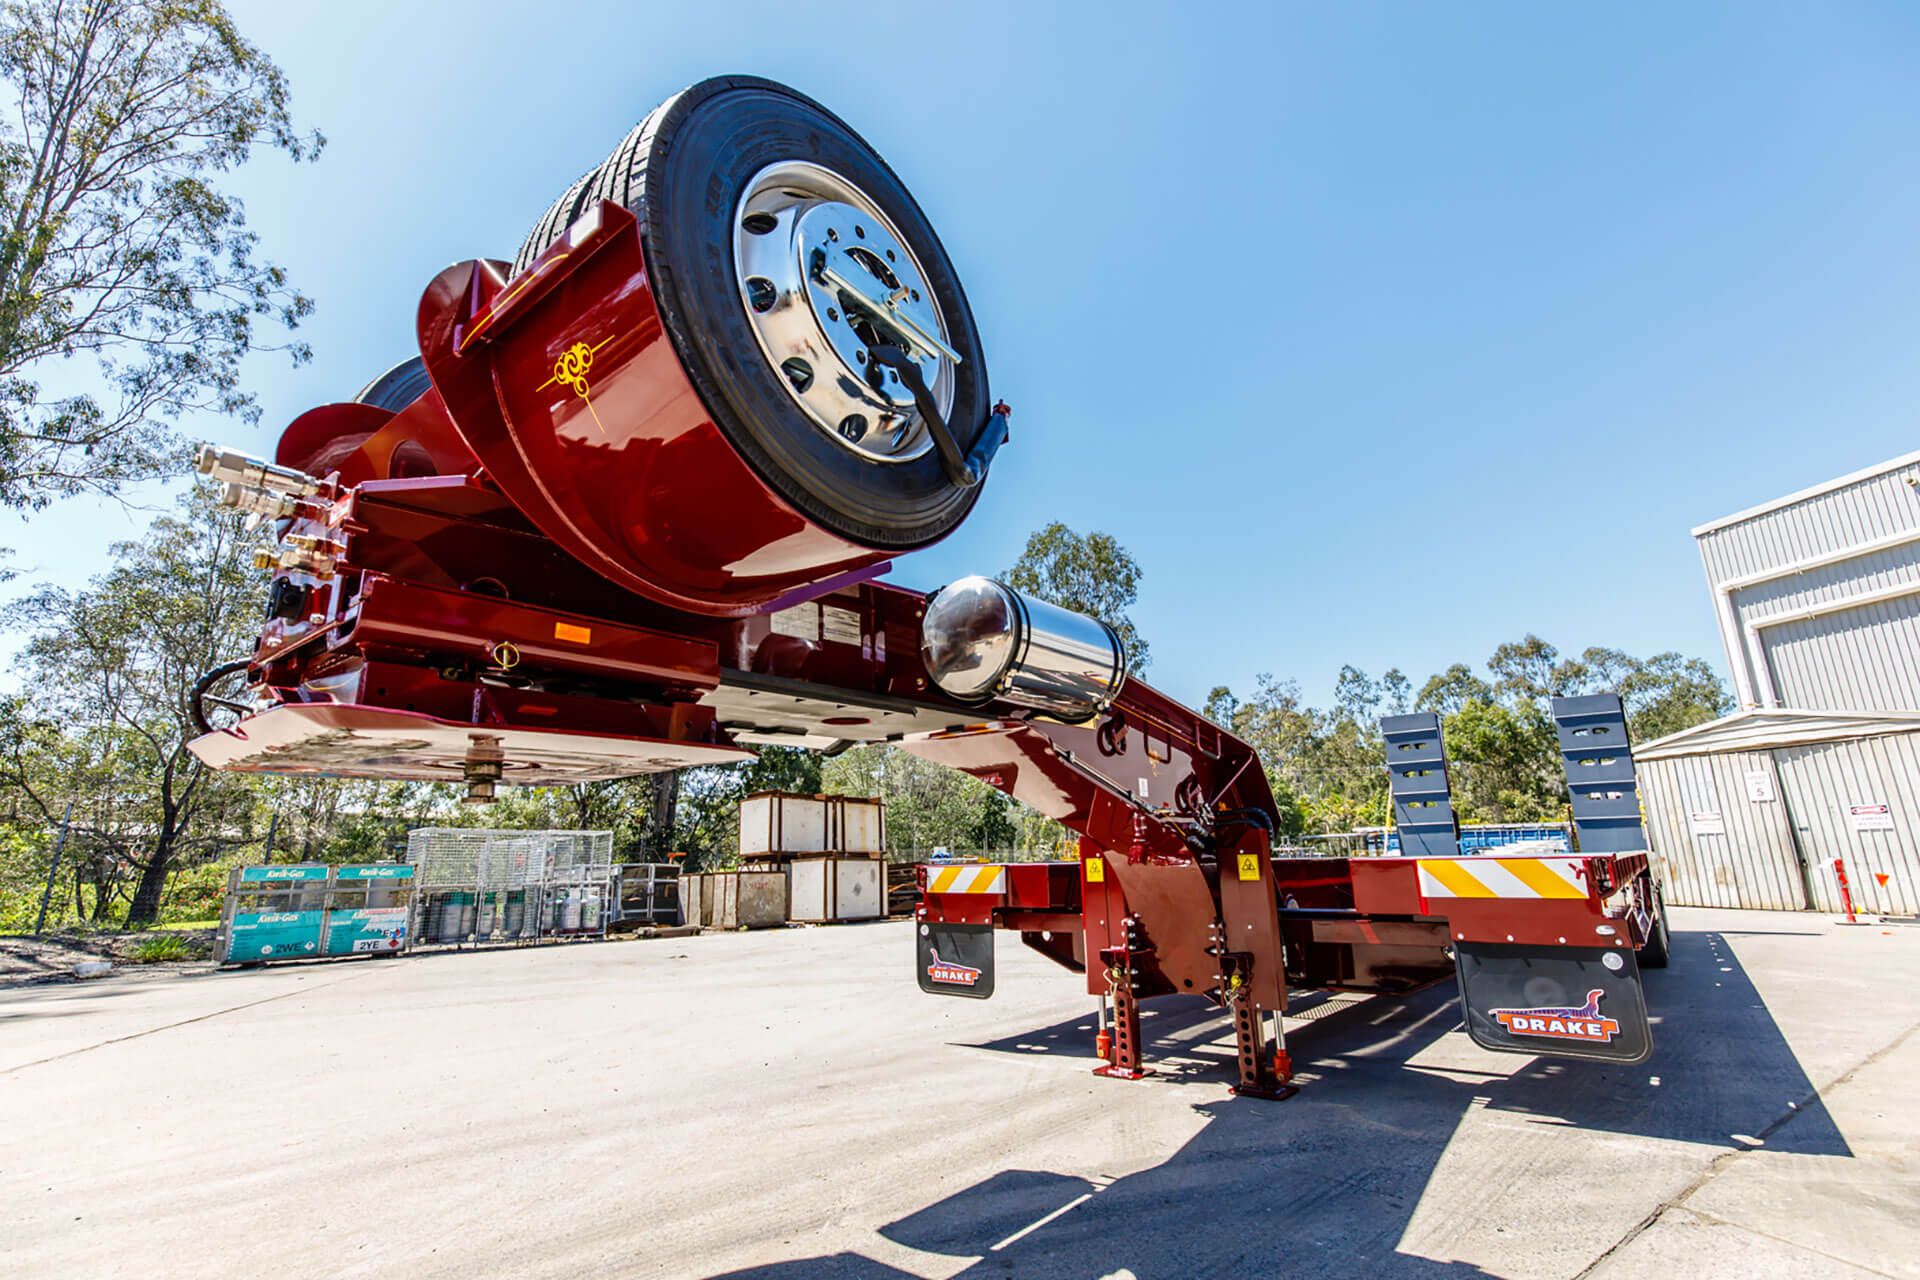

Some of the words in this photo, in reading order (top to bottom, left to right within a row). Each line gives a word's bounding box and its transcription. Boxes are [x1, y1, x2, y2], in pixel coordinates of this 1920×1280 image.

[266, 869, 305, 878] Kwik-Gas
[257, 912, 299, 923] Kwik-Gas
[275, 942, 302, 953] 2WE
[360, 940, 379, 950] 2YE
[934, 970, 972, 981] DRAKE
[1512, 1016, 1603, 1037] DRAKE
